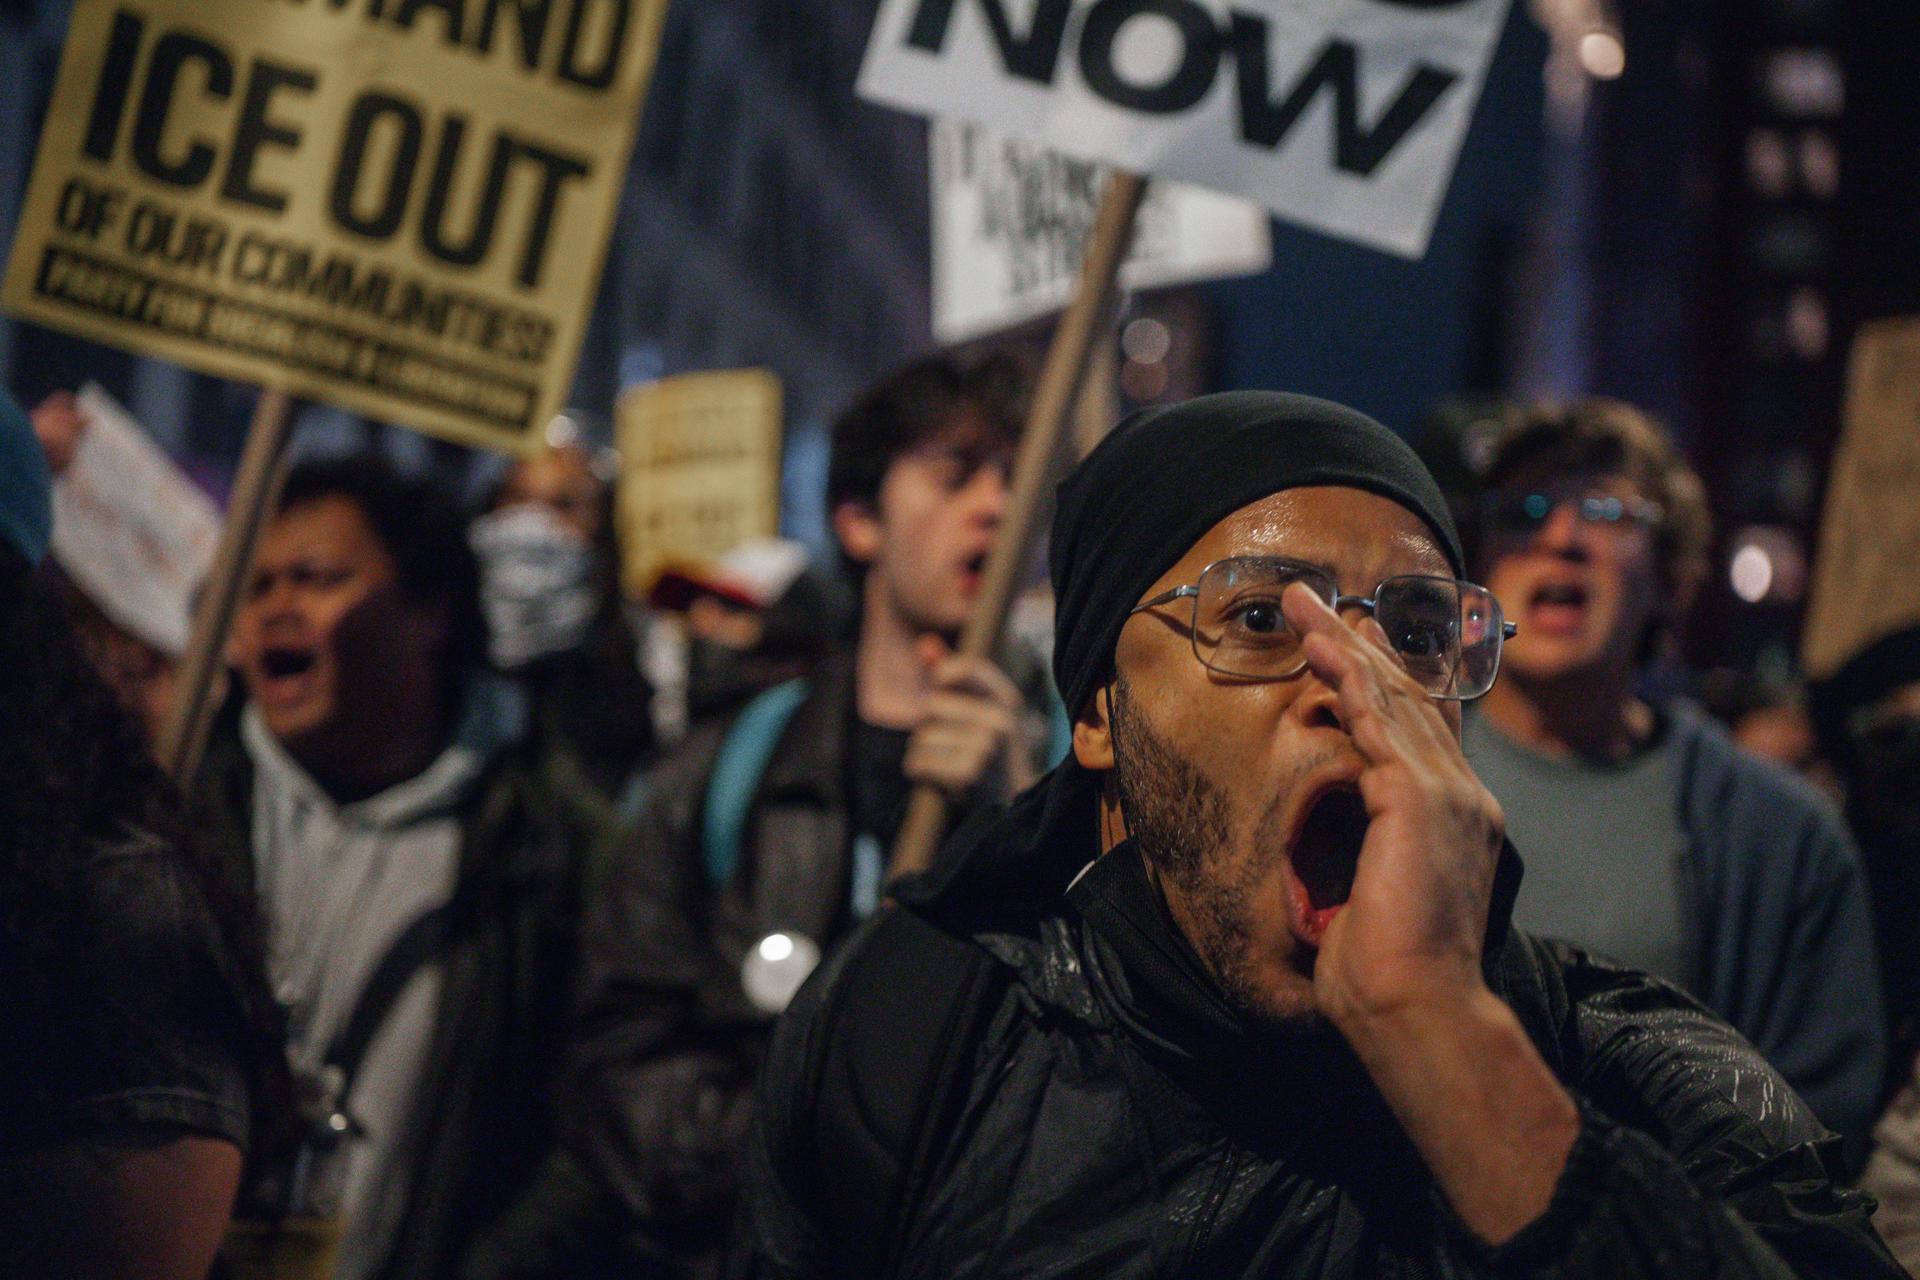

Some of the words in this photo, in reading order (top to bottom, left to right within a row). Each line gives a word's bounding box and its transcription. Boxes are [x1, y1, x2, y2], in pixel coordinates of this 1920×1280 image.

[81, 9, 318, 212] ICE
[330, 86, 592, 290] OUT
[905, 0, 1461, 177] NOW
[57, 179, 126, 238] OF
[127, 203, 230, 273] OUR
